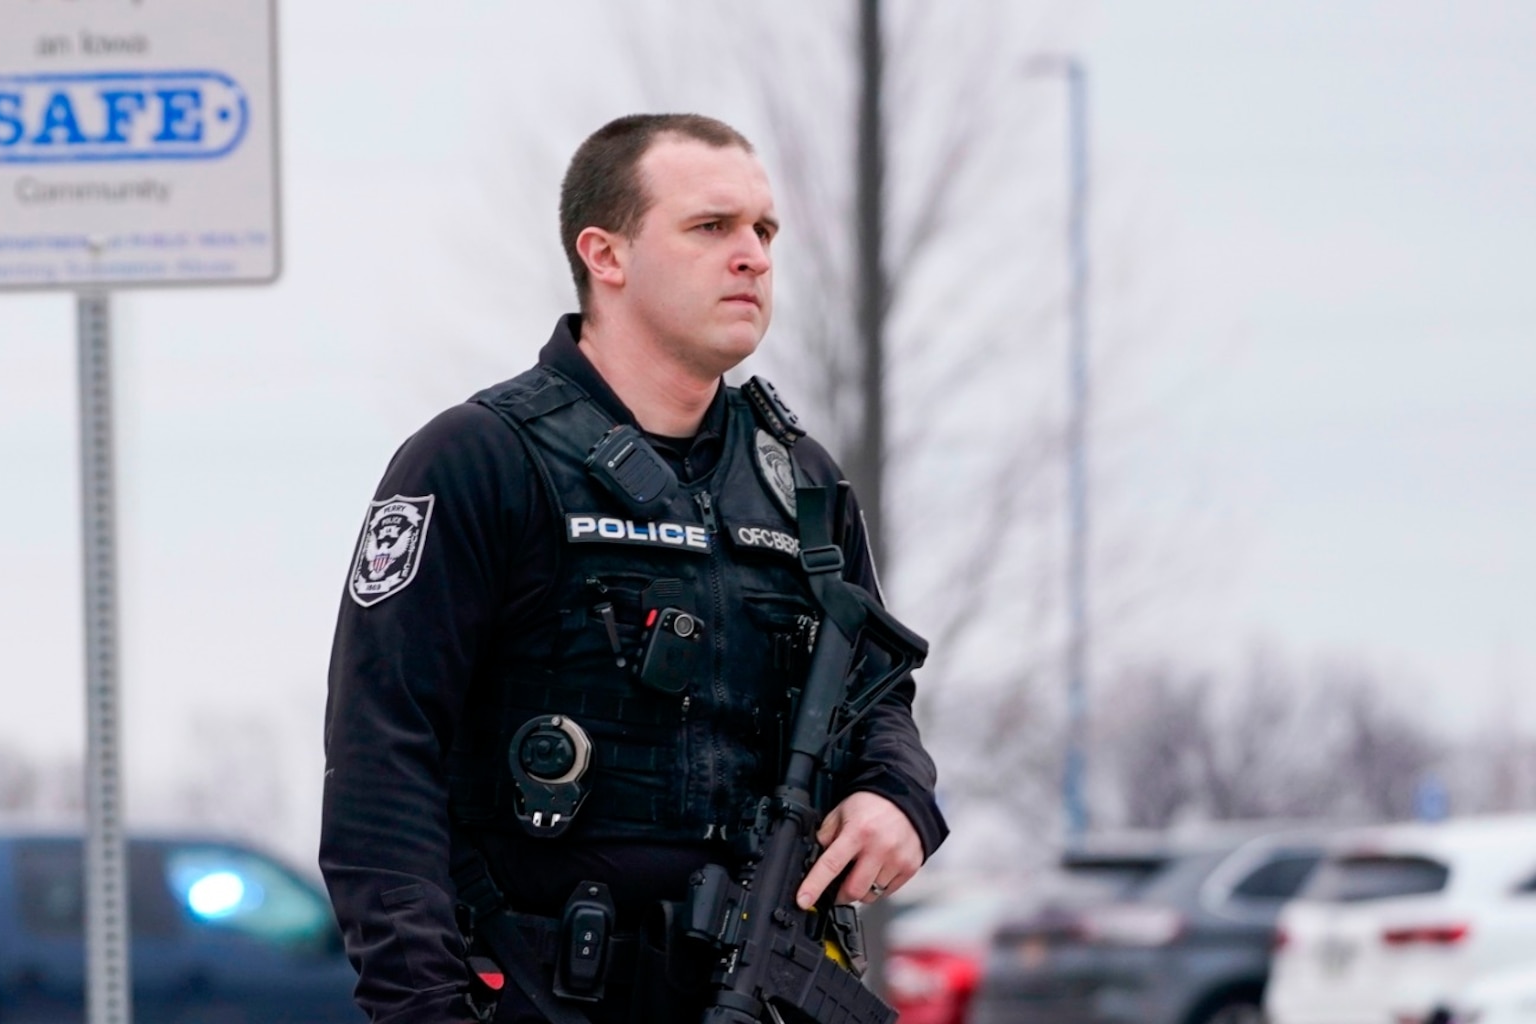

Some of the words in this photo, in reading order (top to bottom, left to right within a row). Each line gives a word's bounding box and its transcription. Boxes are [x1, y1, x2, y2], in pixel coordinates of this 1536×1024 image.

[13, 174, 174, 206] Community
[383, 504, 407, 513] PERRY
[570, 517, 708, 548] POLICE
[737, 527, 774, 547] OFC
